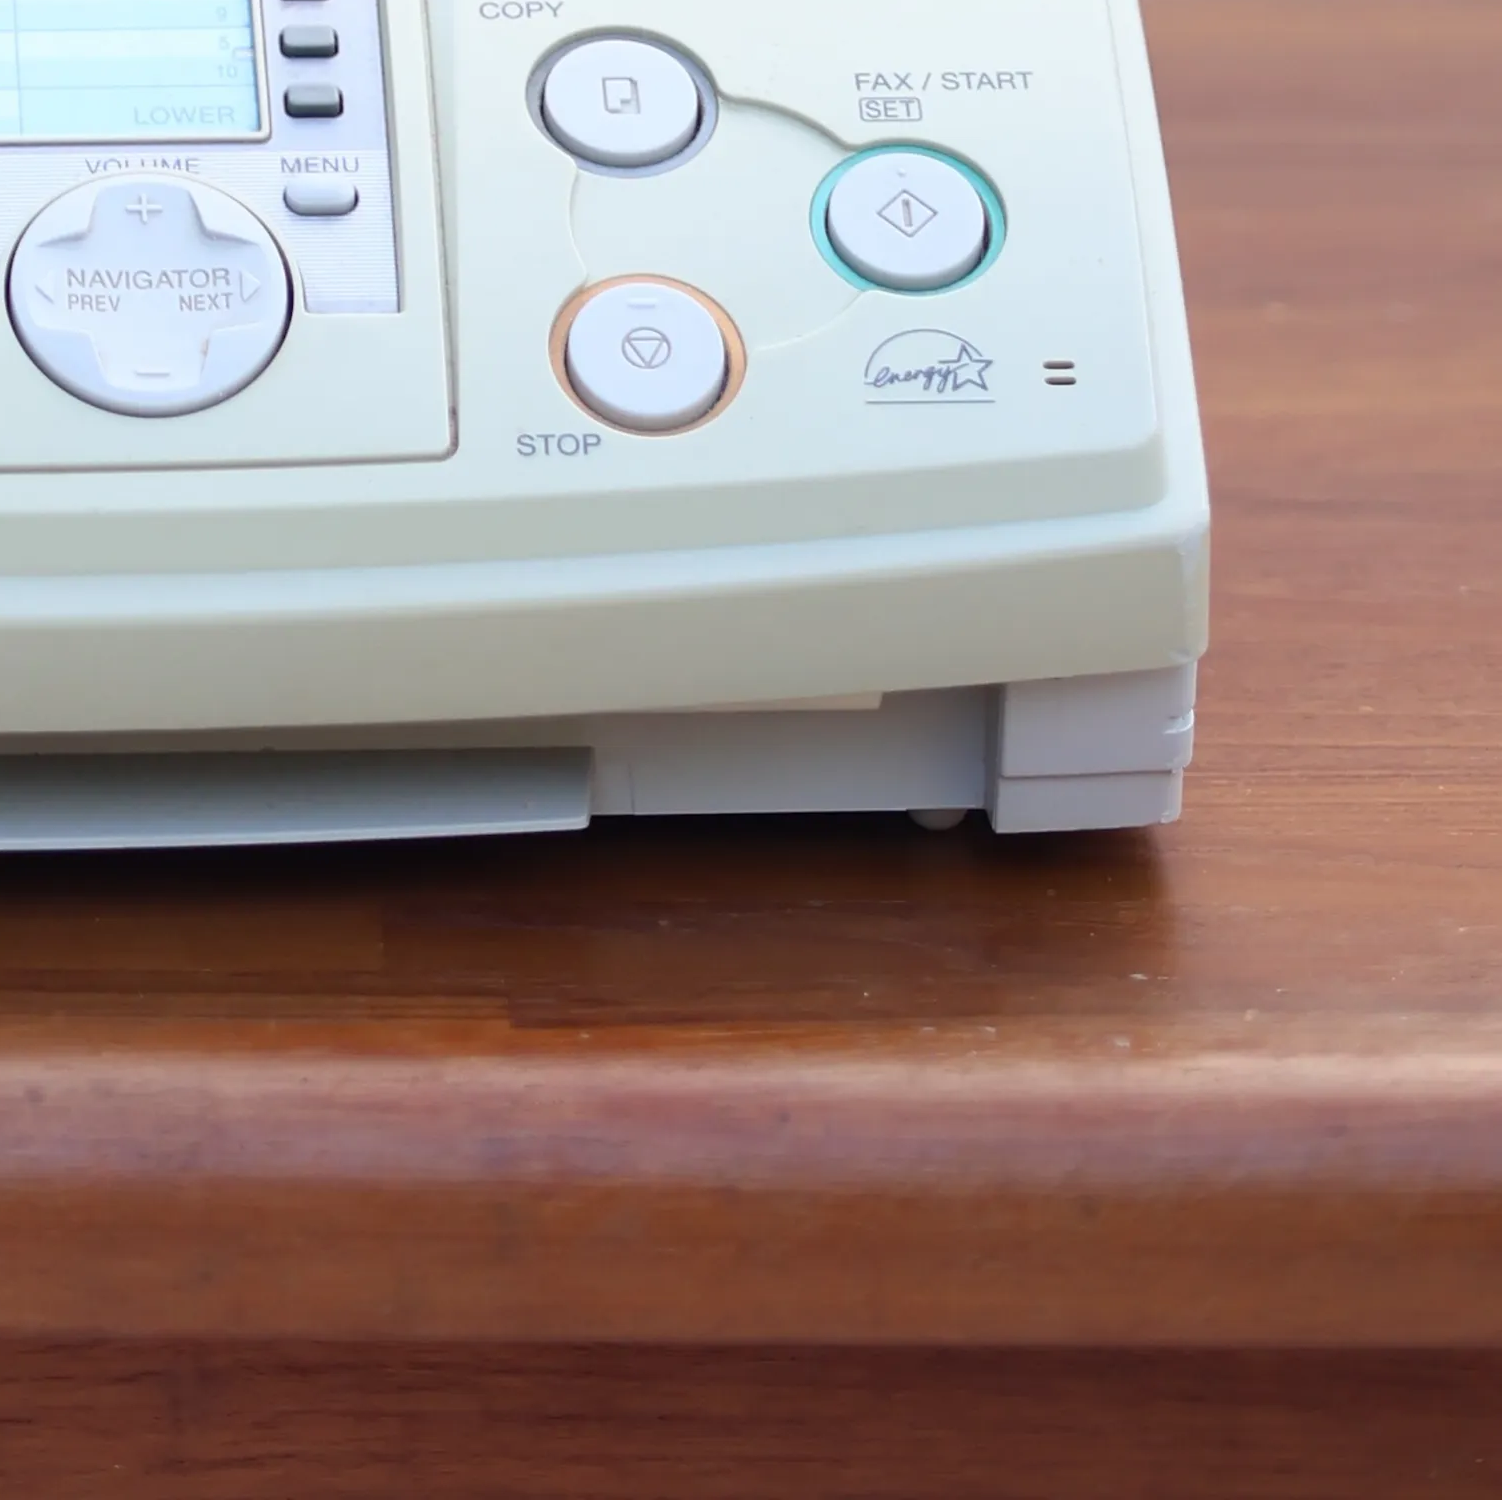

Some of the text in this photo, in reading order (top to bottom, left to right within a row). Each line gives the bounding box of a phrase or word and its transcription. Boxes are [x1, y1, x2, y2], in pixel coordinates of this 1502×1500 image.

[478, 0, 566, 21] COPY
[854, 72, 915, 92] FAX
[940, 71, 1033, 91] START
[133, 106, 236, 125] LOWER
[864, 100, 918, 119] SET
[281, 156, 360, 175] MENU
[66, 267, 232, 292] NAVIGATOR
[67, 292, 234, 313] PREV NEXT
[515, 434, 602, 457] STOP
